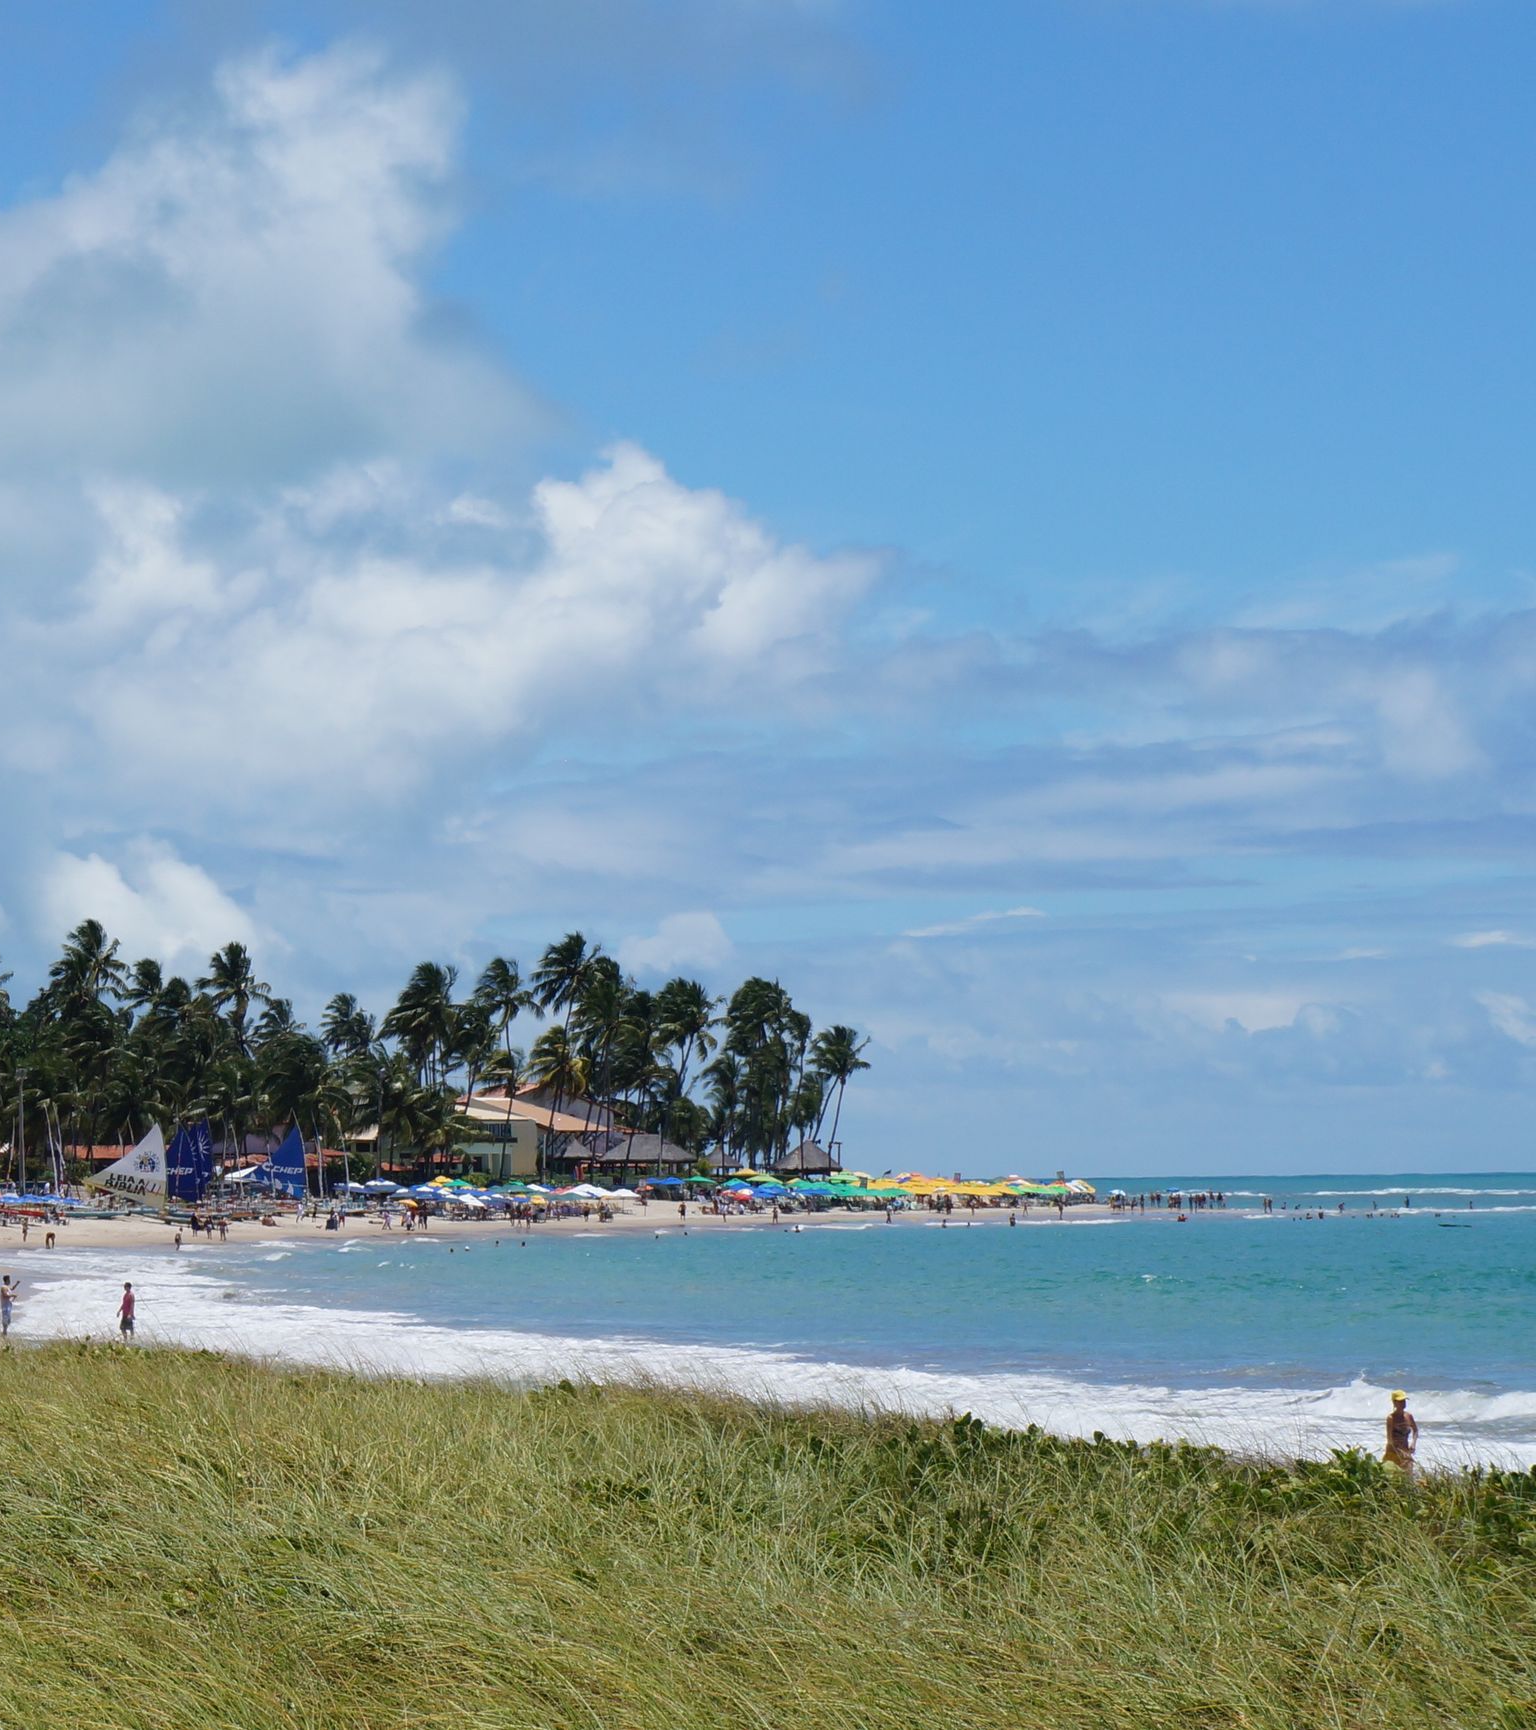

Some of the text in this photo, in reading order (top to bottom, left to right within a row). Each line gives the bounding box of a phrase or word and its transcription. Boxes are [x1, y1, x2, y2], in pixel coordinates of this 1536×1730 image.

[272, 1165, 303, 1175] CHEP
[109, 1173, 135, 1184] LEIA
[104, 1179, 146, 1196] BIBLIA
